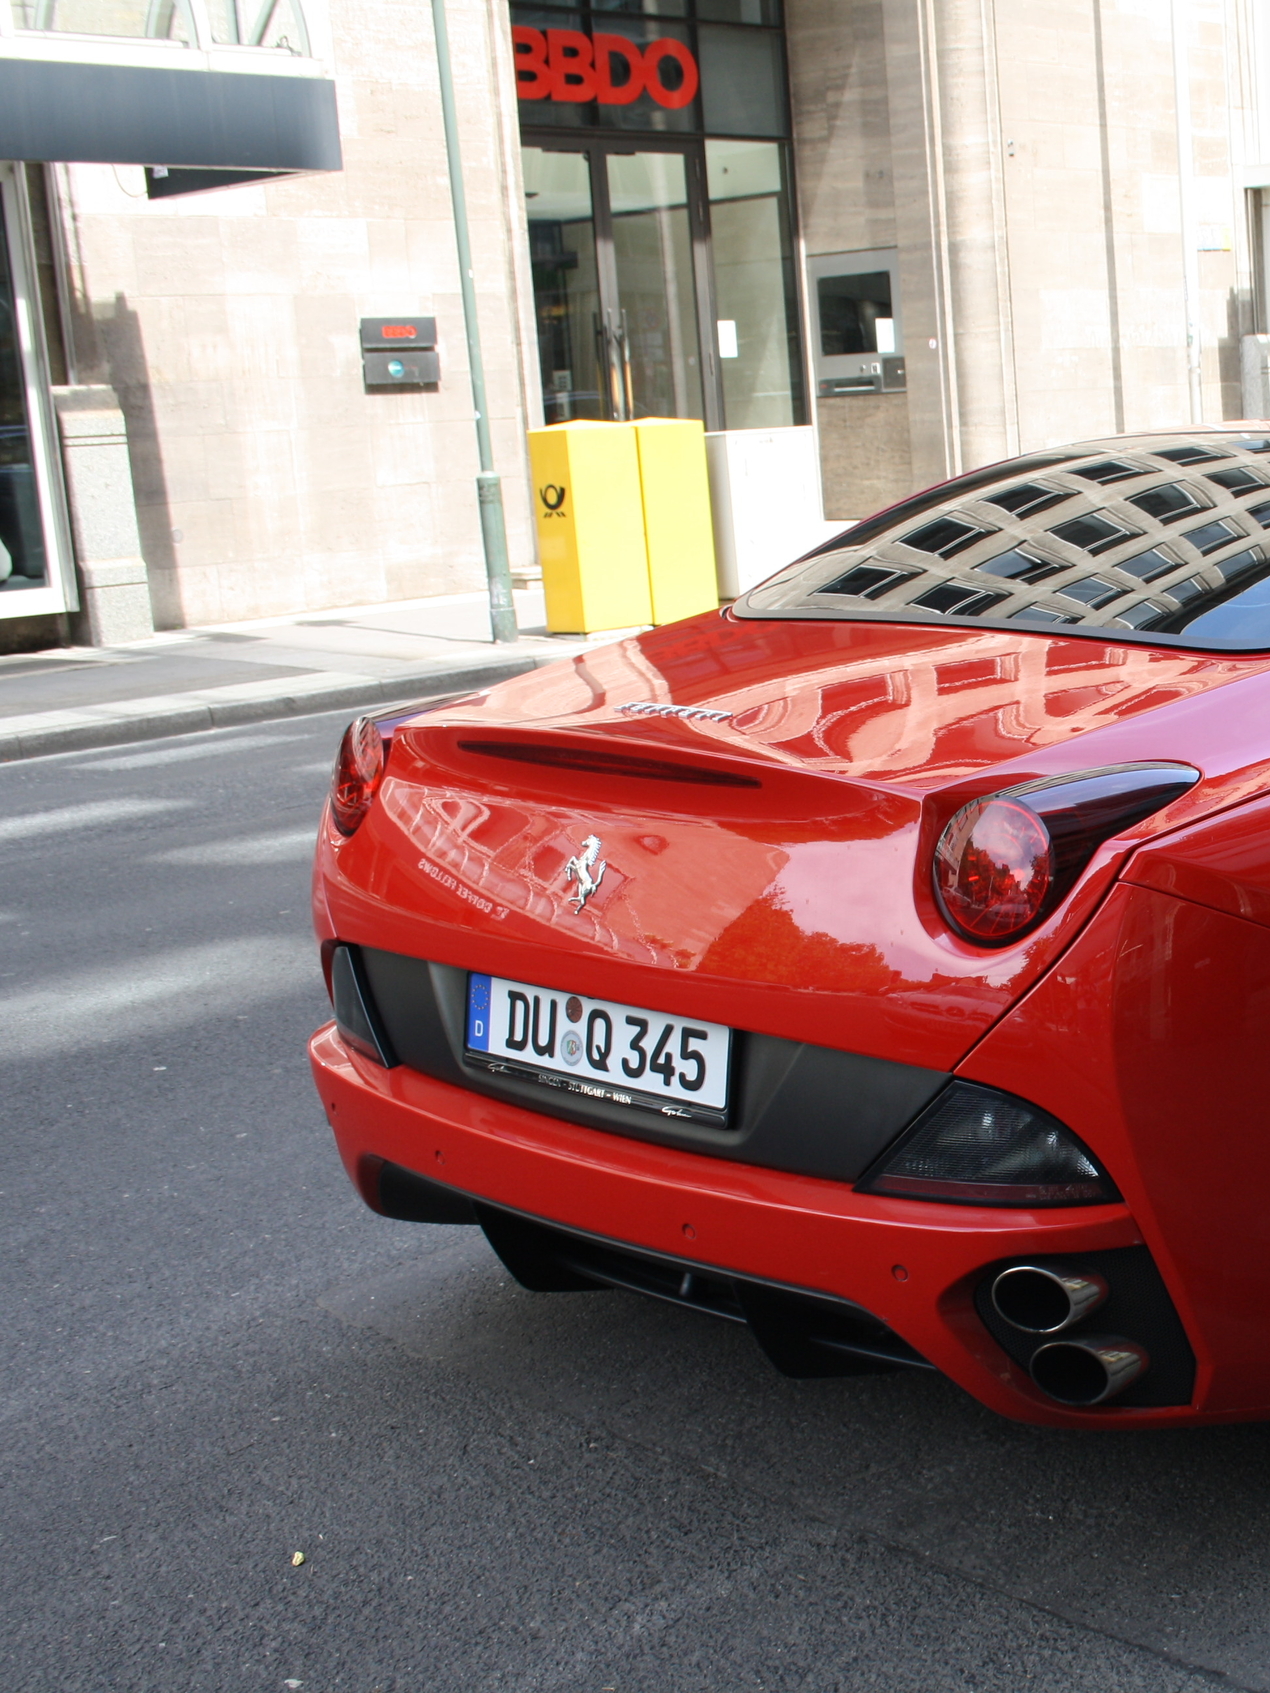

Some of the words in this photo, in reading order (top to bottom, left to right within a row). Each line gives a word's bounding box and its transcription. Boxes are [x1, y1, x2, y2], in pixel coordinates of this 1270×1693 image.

[511, 25, 699, 109] BBDO
[613, 702, 733, 722] Ferrari
[475, 1020, 484, 1037] D
[505, 989, 558, 1059] DU
[586, 1008, 613, 1072] Q
[621, 1014, 708, 1091] 345
[538, 1073, 562, 1088] SINGEN
[567, 1081, 605, 1098] STUTTGART
[612, 1092, 632, 1105] WIEN
